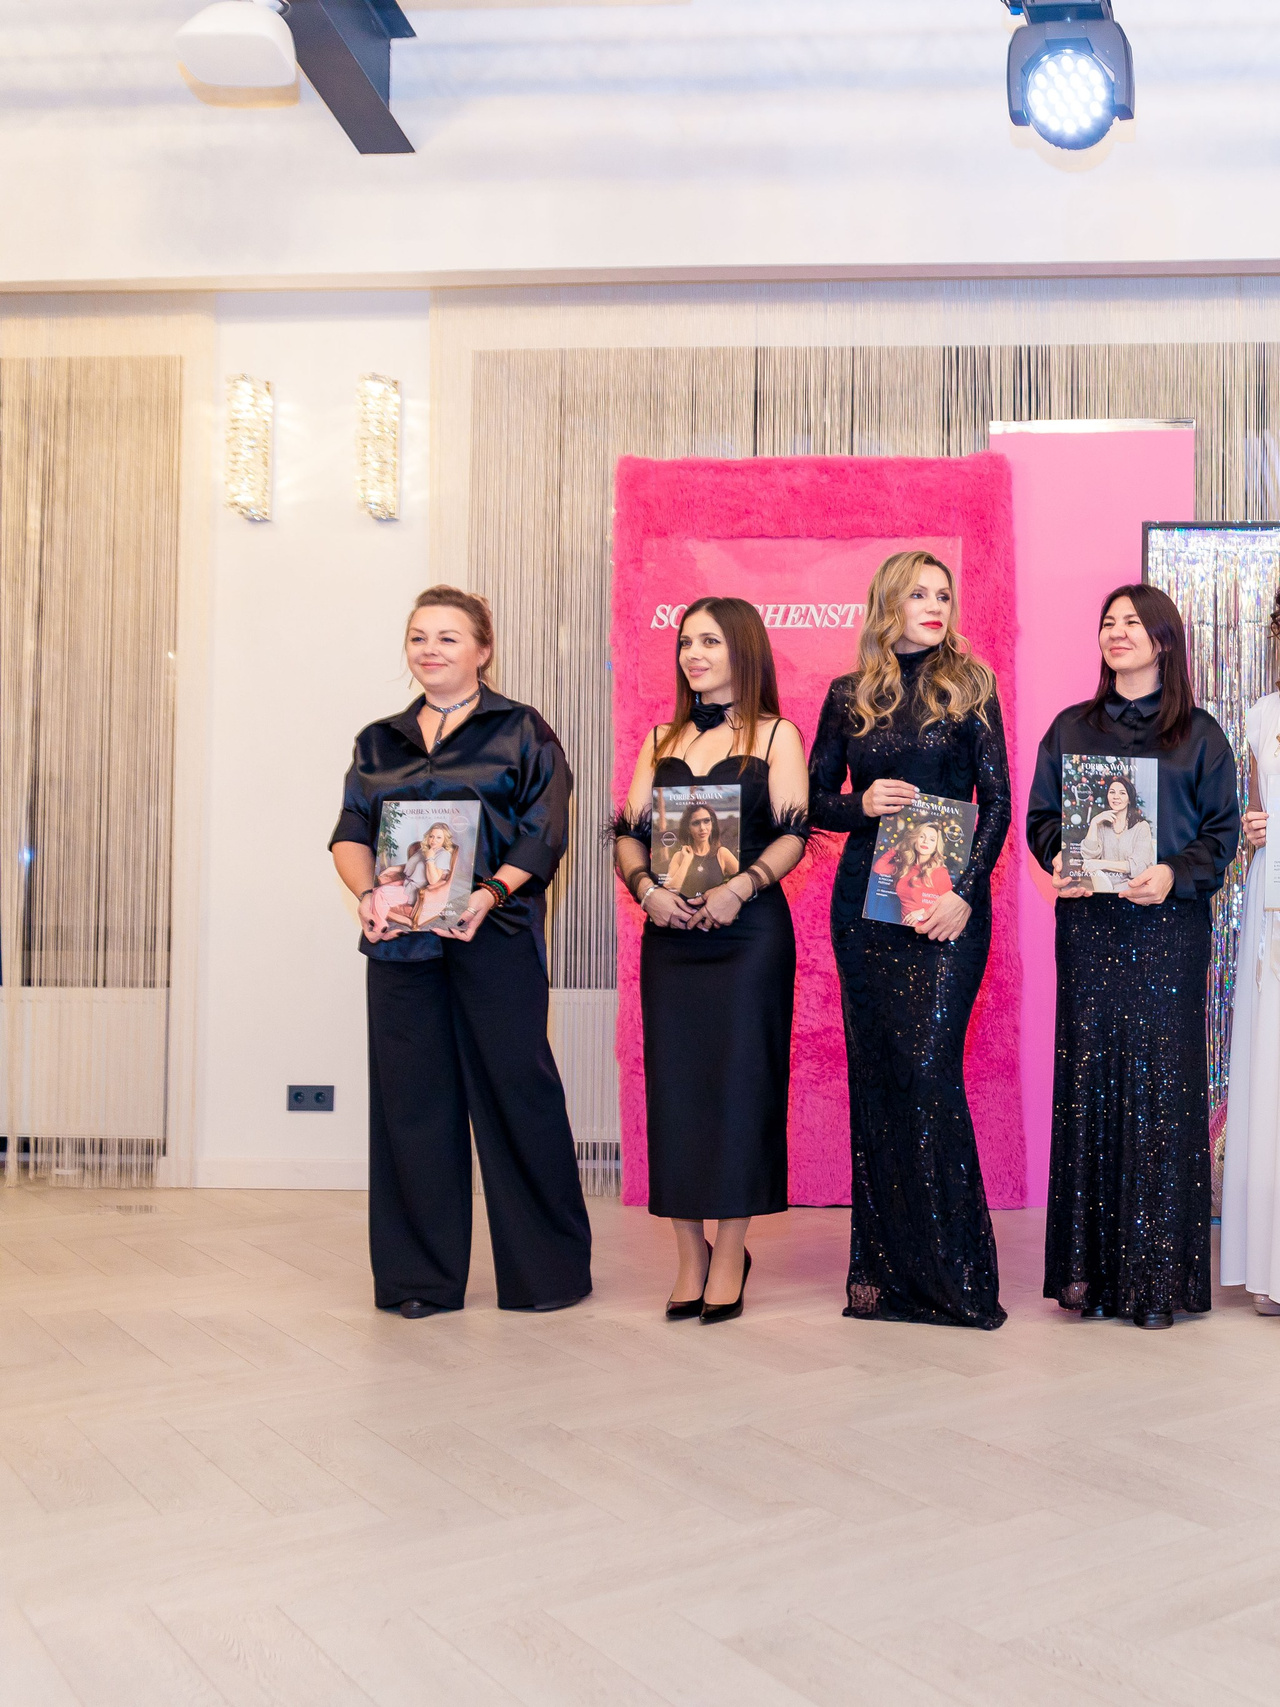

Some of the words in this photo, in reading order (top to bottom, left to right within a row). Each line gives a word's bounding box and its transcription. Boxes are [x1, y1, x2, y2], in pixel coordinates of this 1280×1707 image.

[1110, 762, 1138, 771] WOMAN
[670, 793, 695, 801] FORBES
[695, 792, 723, 800] WOMAN
[431, 807, 460, 815] WOMAN
[931, 802, 960, 815] WOMAN
